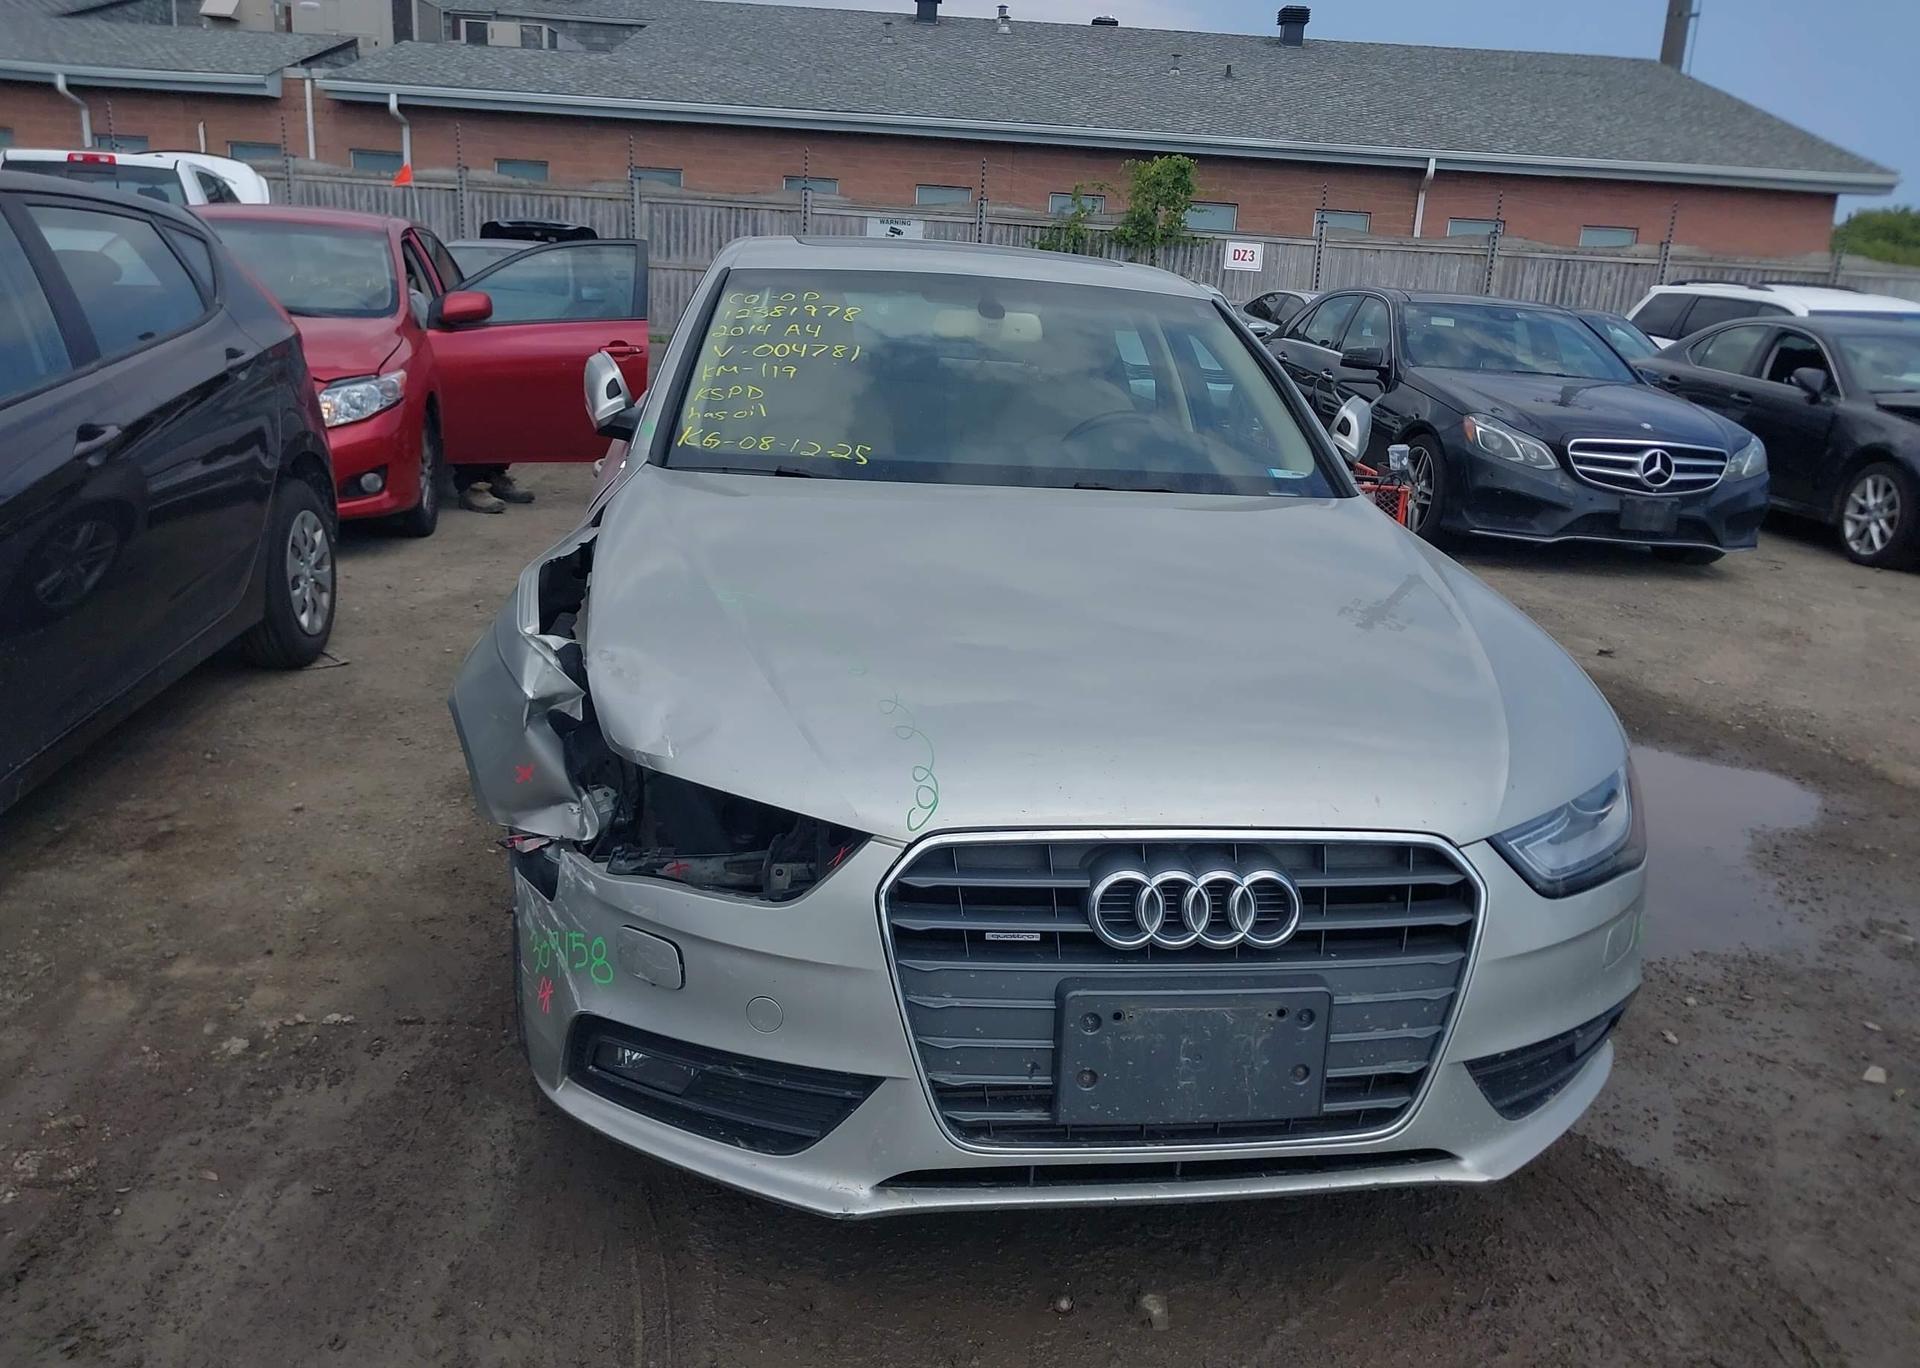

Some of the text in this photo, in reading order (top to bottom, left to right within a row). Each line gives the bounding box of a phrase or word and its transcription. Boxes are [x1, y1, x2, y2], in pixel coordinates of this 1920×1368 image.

[879, 218, 912, 226] WARNING
[1233, 248, 1256, 262] DZ3
[711, 324, 822, 338] 2014 A4
